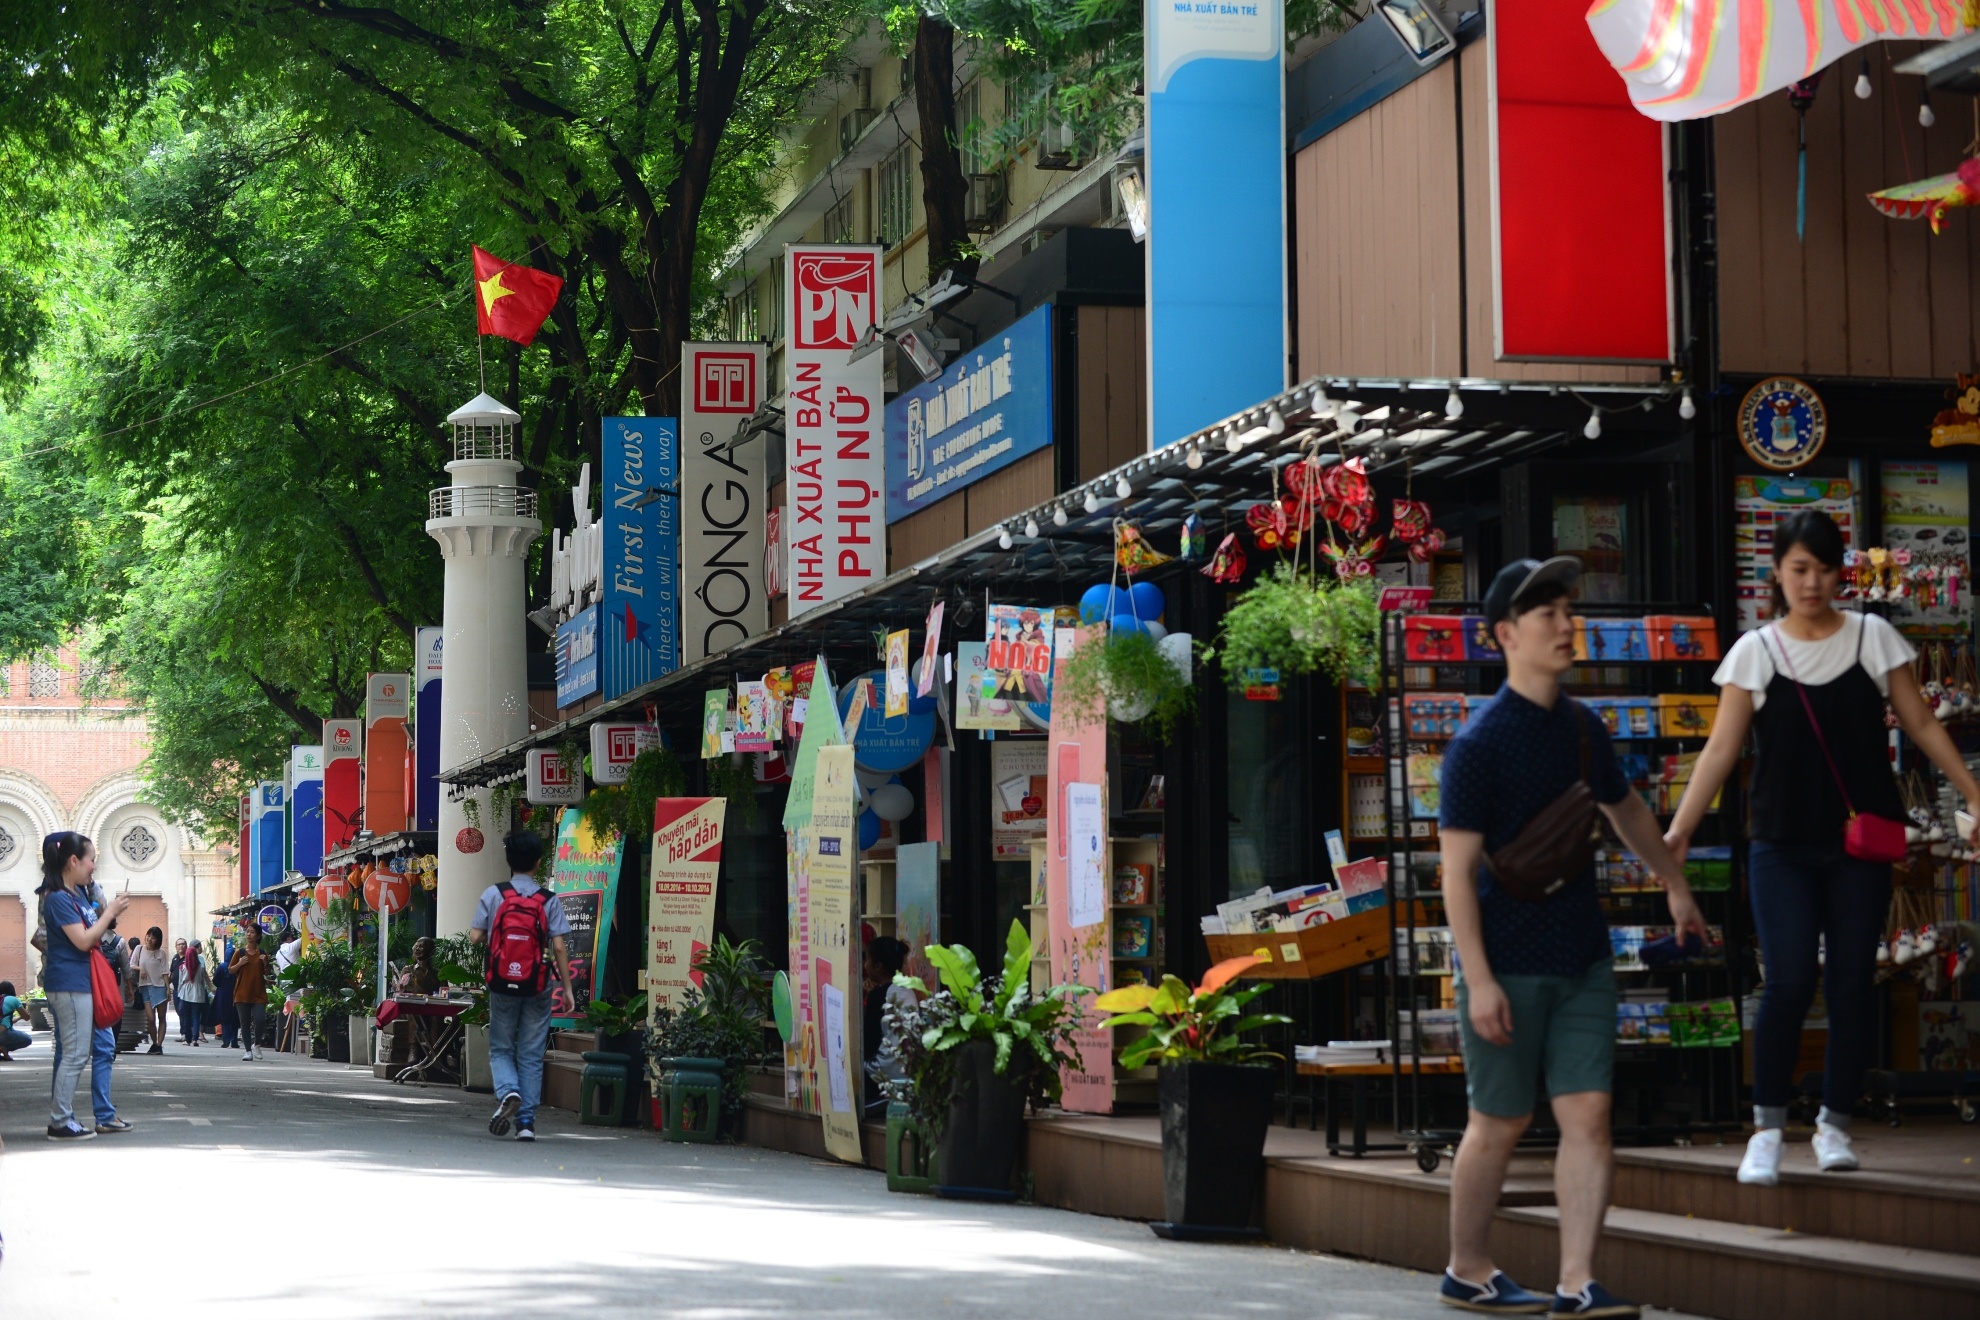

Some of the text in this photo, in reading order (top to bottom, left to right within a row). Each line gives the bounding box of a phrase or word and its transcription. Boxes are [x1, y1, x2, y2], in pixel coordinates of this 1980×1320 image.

[659, 427, 674, 461] way
[664, 466, 671, 476] a
[789, 362, 823, 601] NHÀ XUẤT BẢN
[829, 386, 879, 577] PHỤ NỮ
[614, 429, 643, 599] First News
[656, 556, 671, 586] will
[664, 591, 671, 601] a
[657, 606, 671, 660] there's
